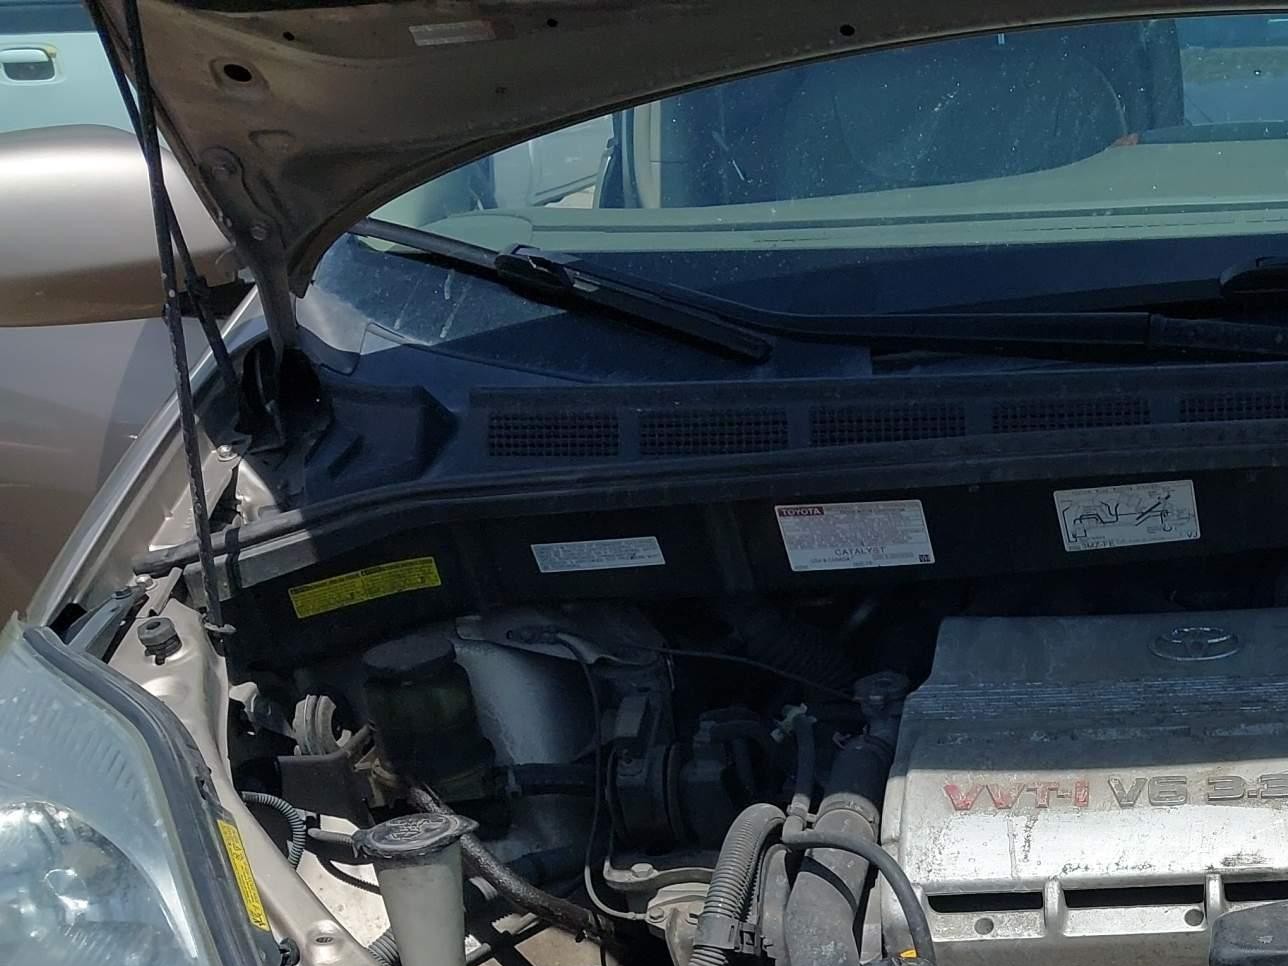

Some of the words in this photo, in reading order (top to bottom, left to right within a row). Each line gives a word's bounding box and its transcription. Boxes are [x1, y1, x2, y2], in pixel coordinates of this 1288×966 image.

[781, 508, 821, 516] TOYOTA
[834, 547, 886, 556] CATALYST
[1107, 775, 1189, 808] V6
